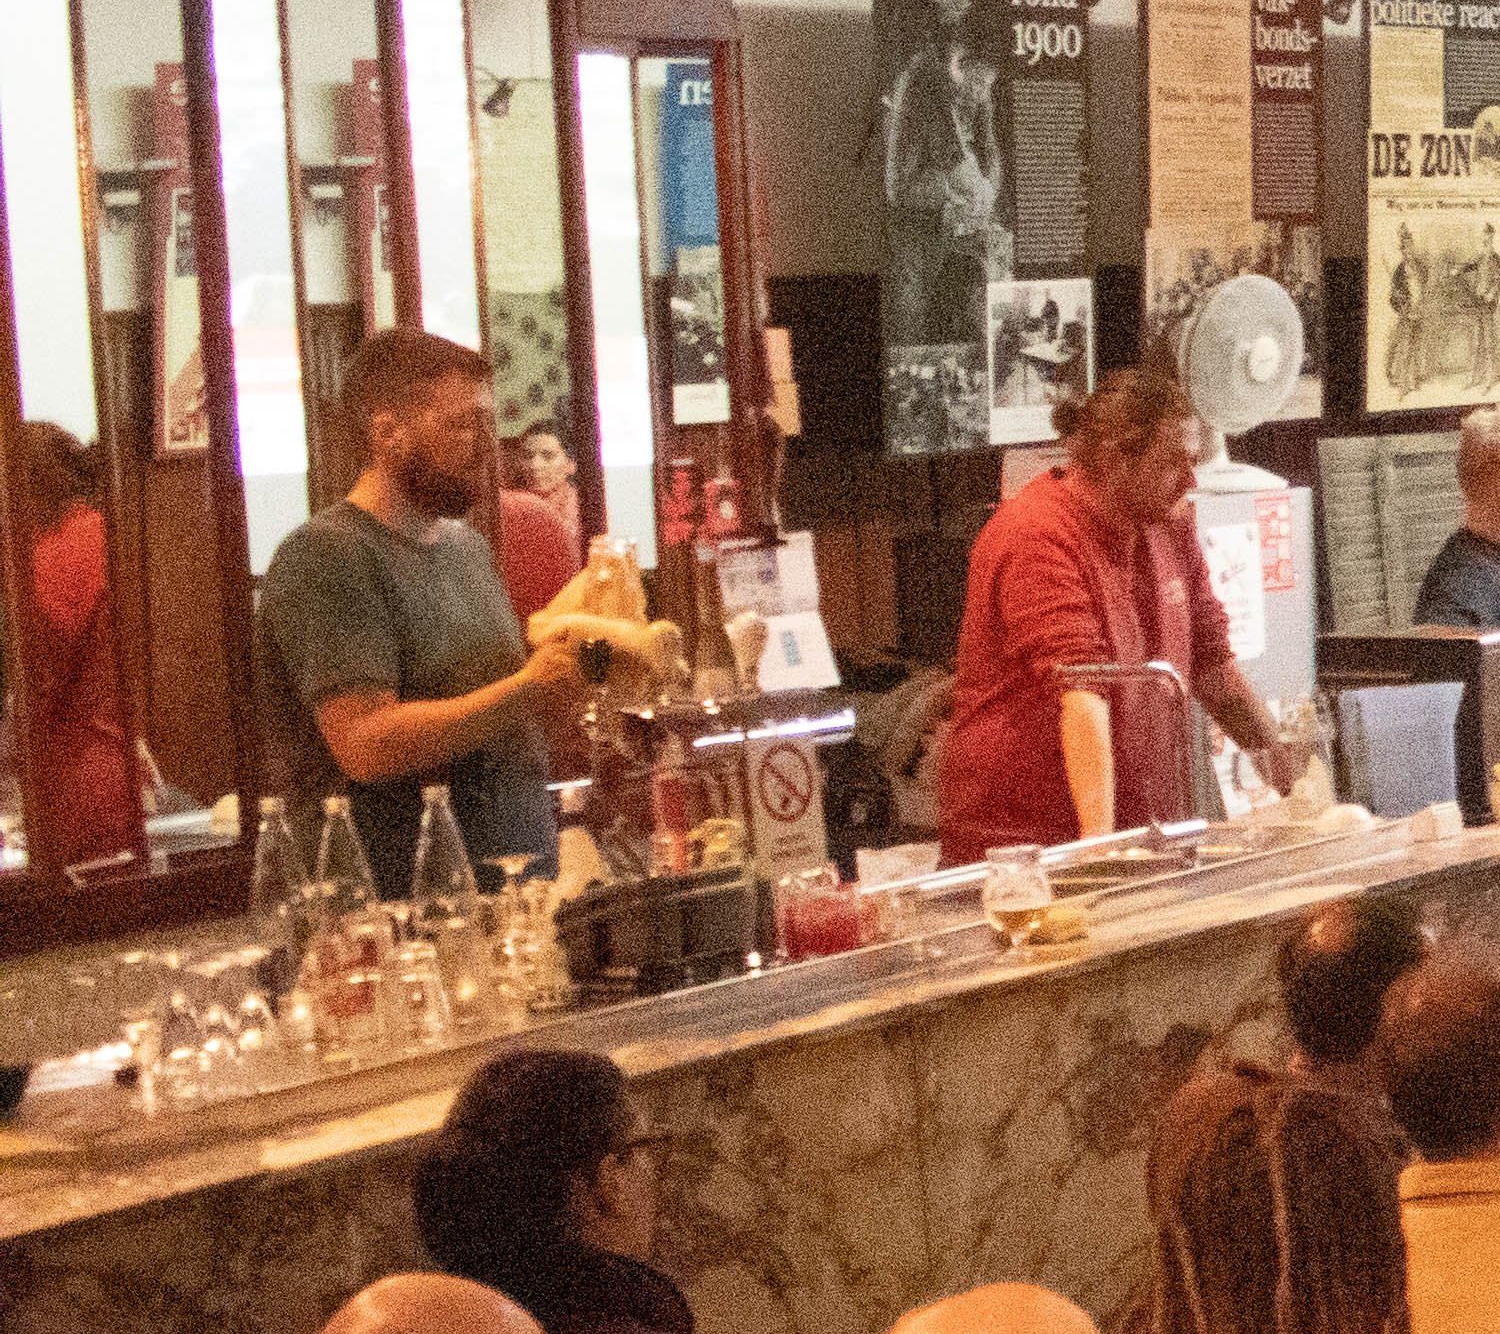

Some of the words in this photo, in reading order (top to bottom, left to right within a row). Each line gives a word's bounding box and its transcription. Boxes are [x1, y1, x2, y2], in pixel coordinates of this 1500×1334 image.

[1011, 21, 1083, 66] 1900
[1254, 16, 1319, 53] bonds-
[1254, 61, 1315, 91] verzet
[1371, 133, 1413, 178] DE
[1420, 133, 1473, 178] ZON
